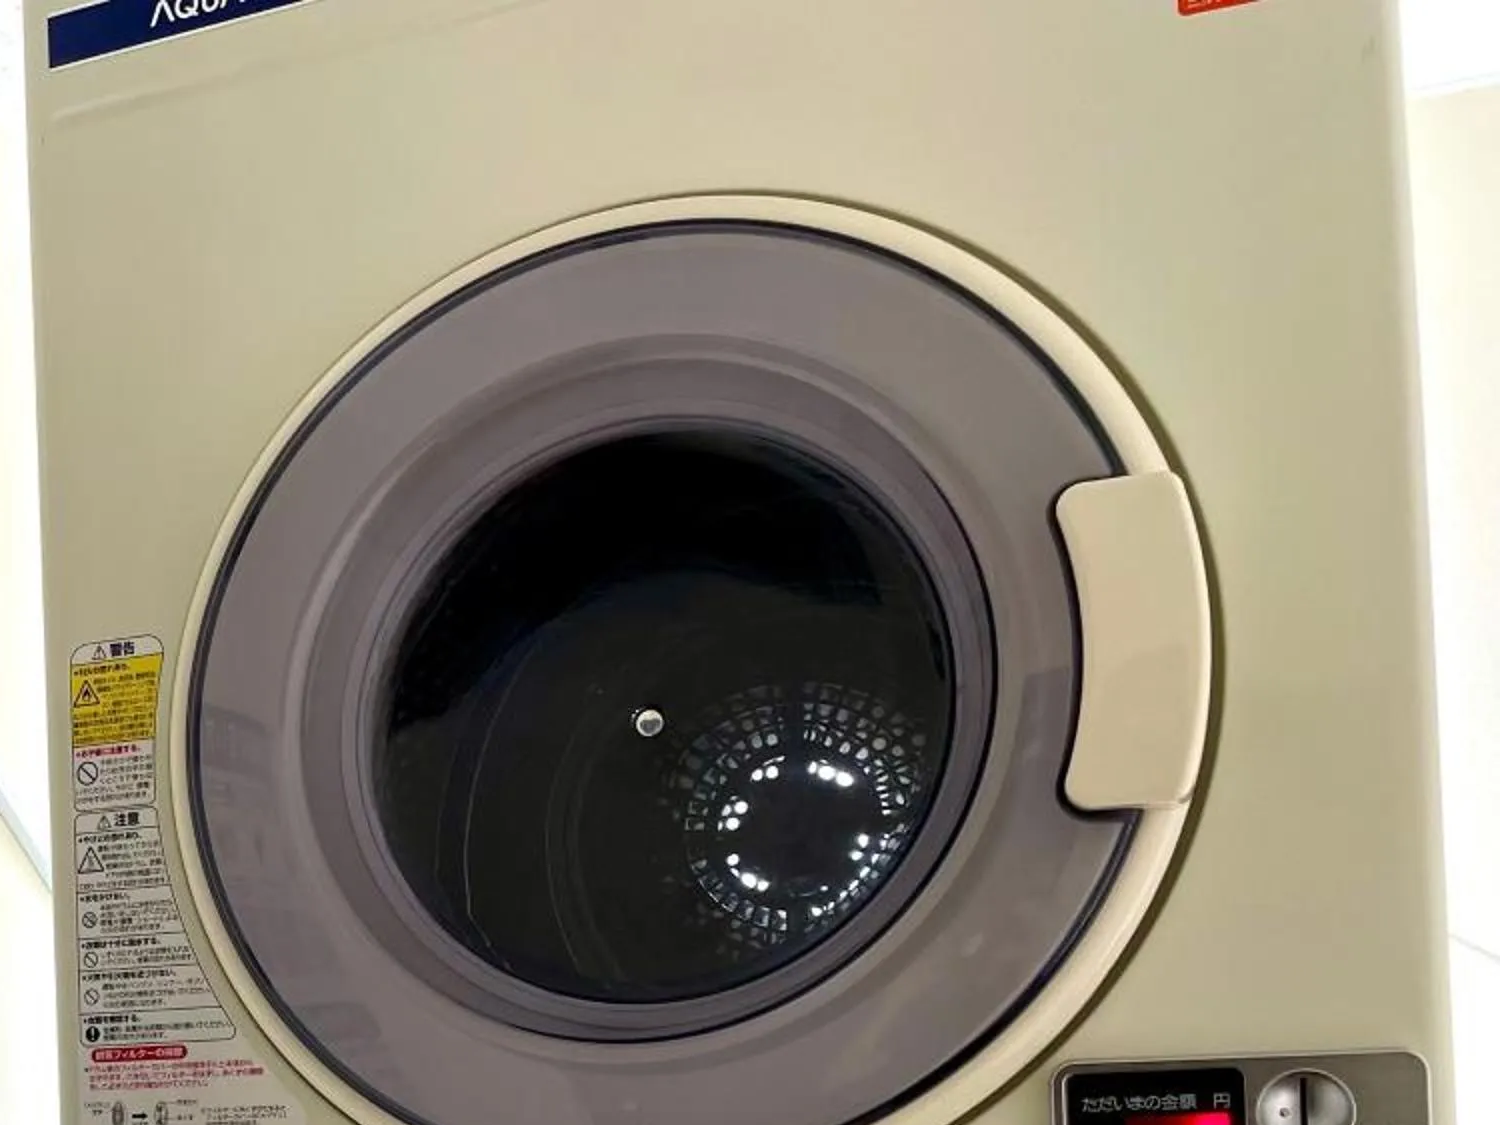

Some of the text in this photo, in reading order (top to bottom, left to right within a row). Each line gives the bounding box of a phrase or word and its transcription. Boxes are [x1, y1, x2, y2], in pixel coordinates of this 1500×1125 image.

[114, 812, 140, 827] 注意
[1082, 1093, 1232, 1113] ただいまの金額 円
